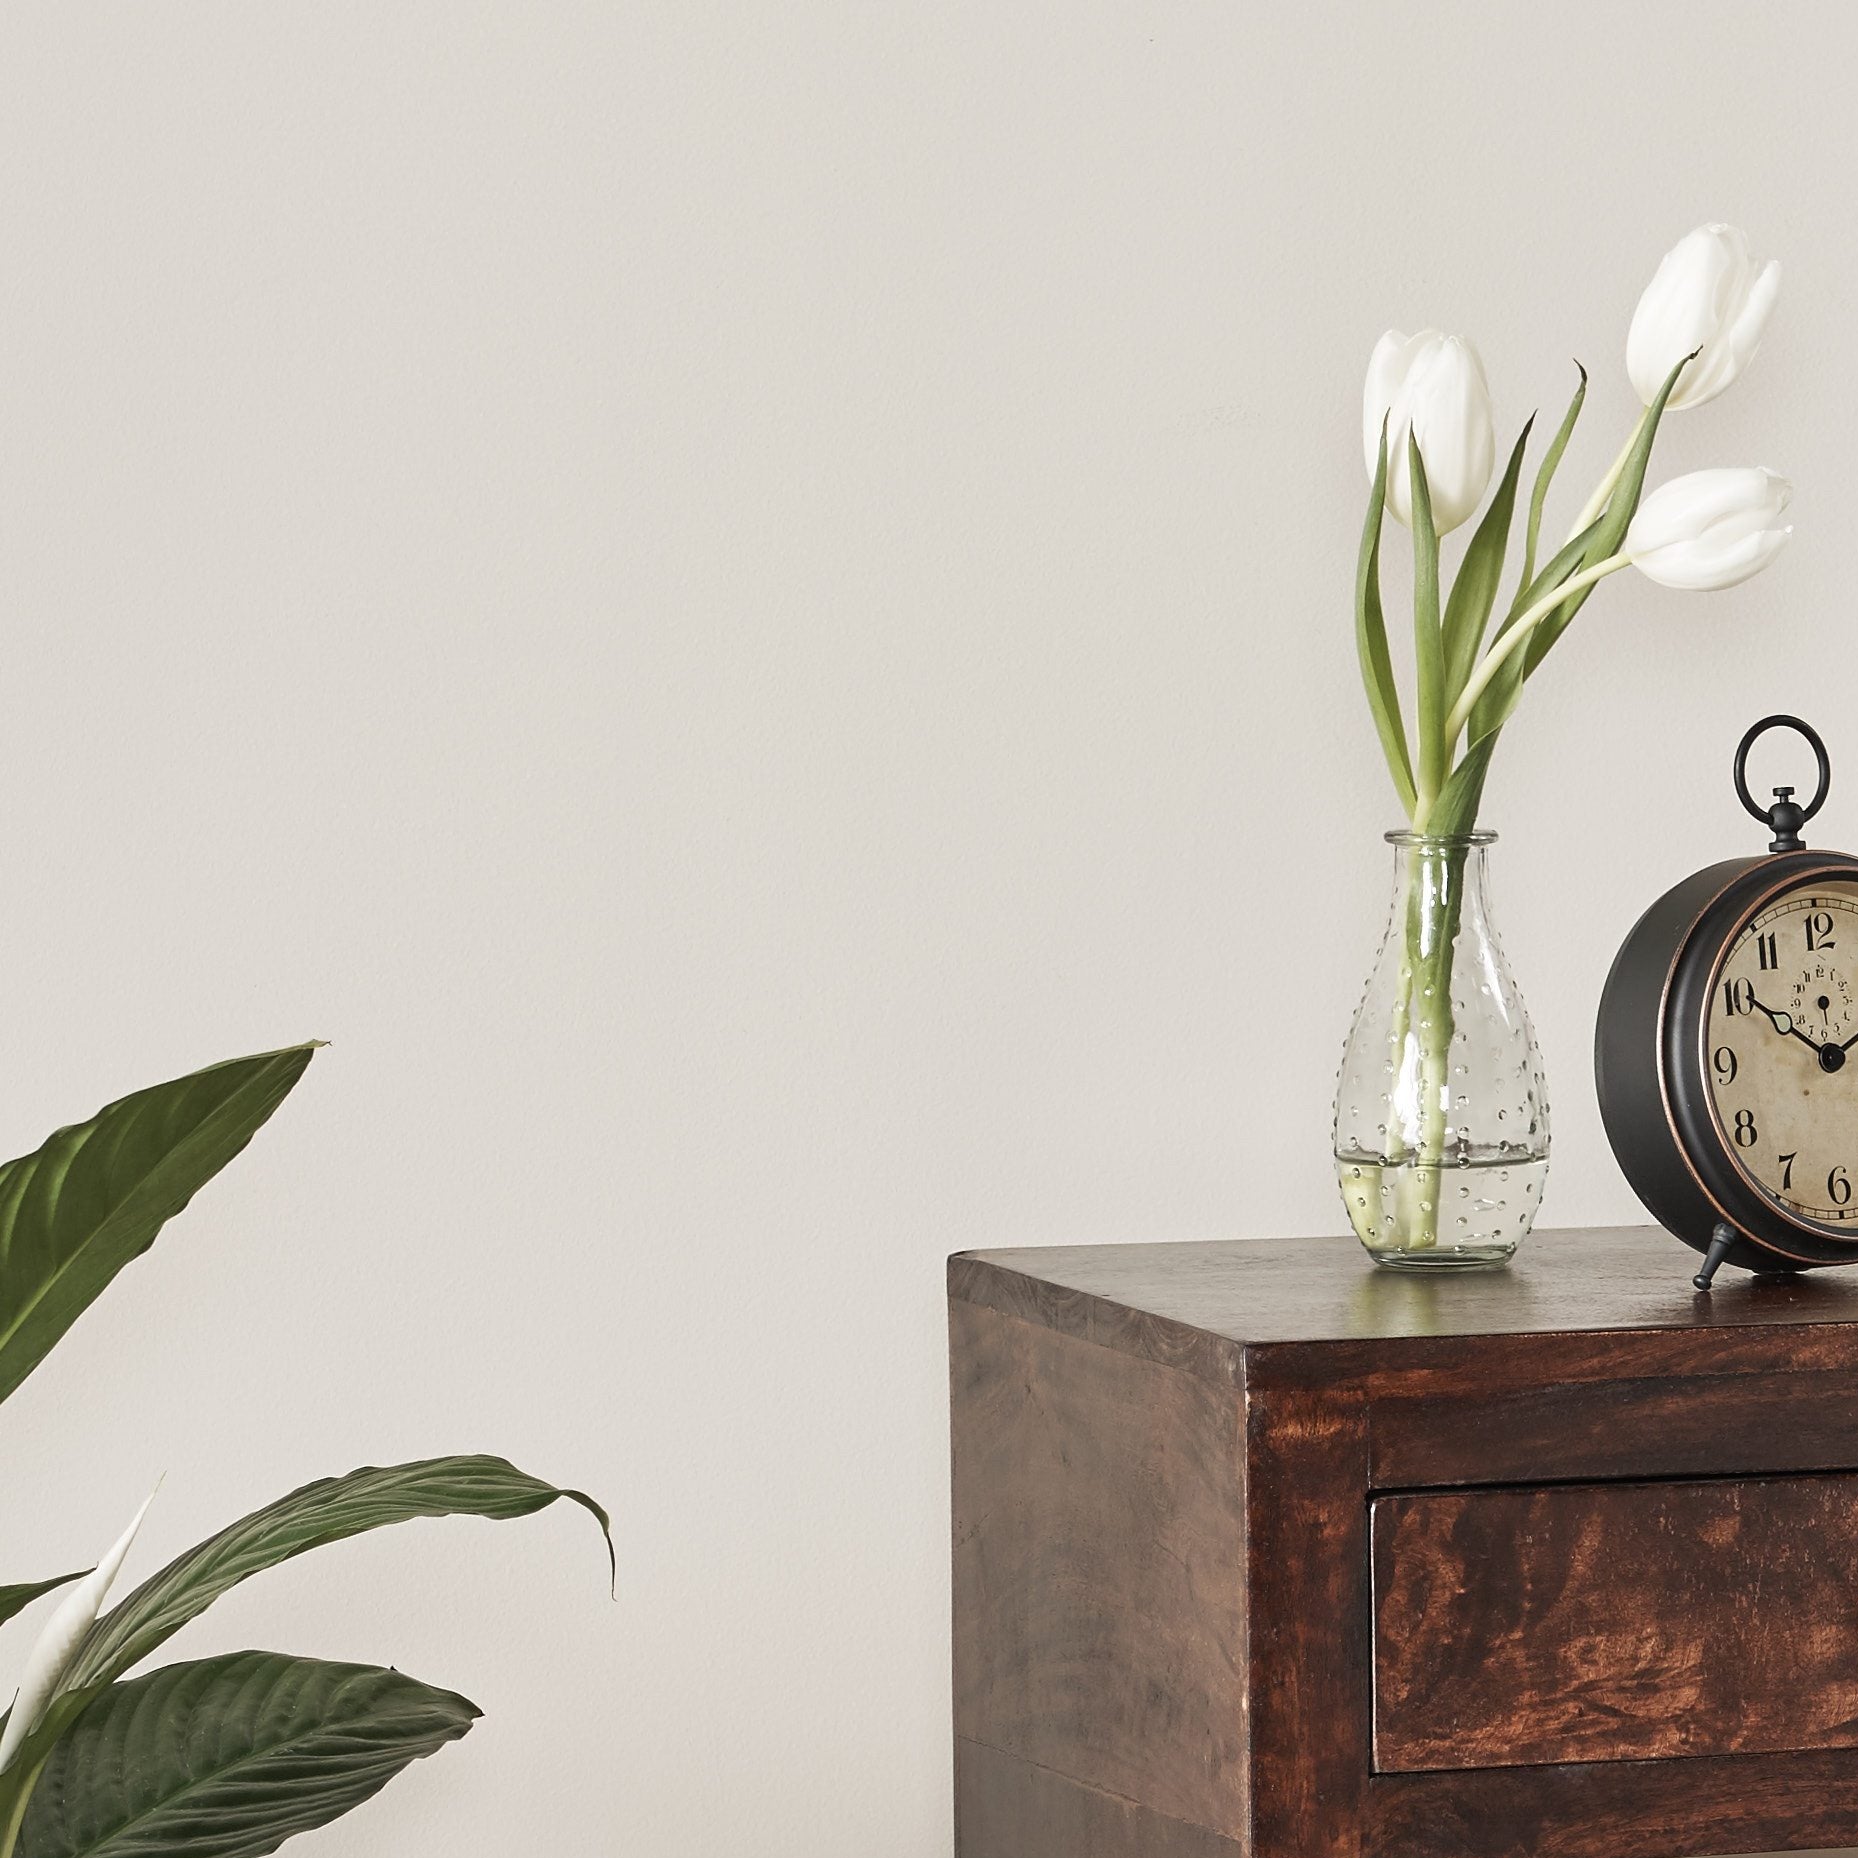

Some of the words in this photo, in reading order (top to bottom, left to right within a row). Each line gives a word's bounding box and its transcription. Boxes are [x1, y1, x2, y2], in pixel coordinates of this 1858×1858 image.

[1757, 932, 1779, 970] 11
[1803, 912, 1835, 951] 12
[1723, 976, 1755, 1016] 10
[1713, 1047, 1738, 1085] 9
[1734, 1109, 1758, 1147] 8
[1778, 1151, 1798, 1190] 7
[1827, 1165, 1851, 1204] 6
